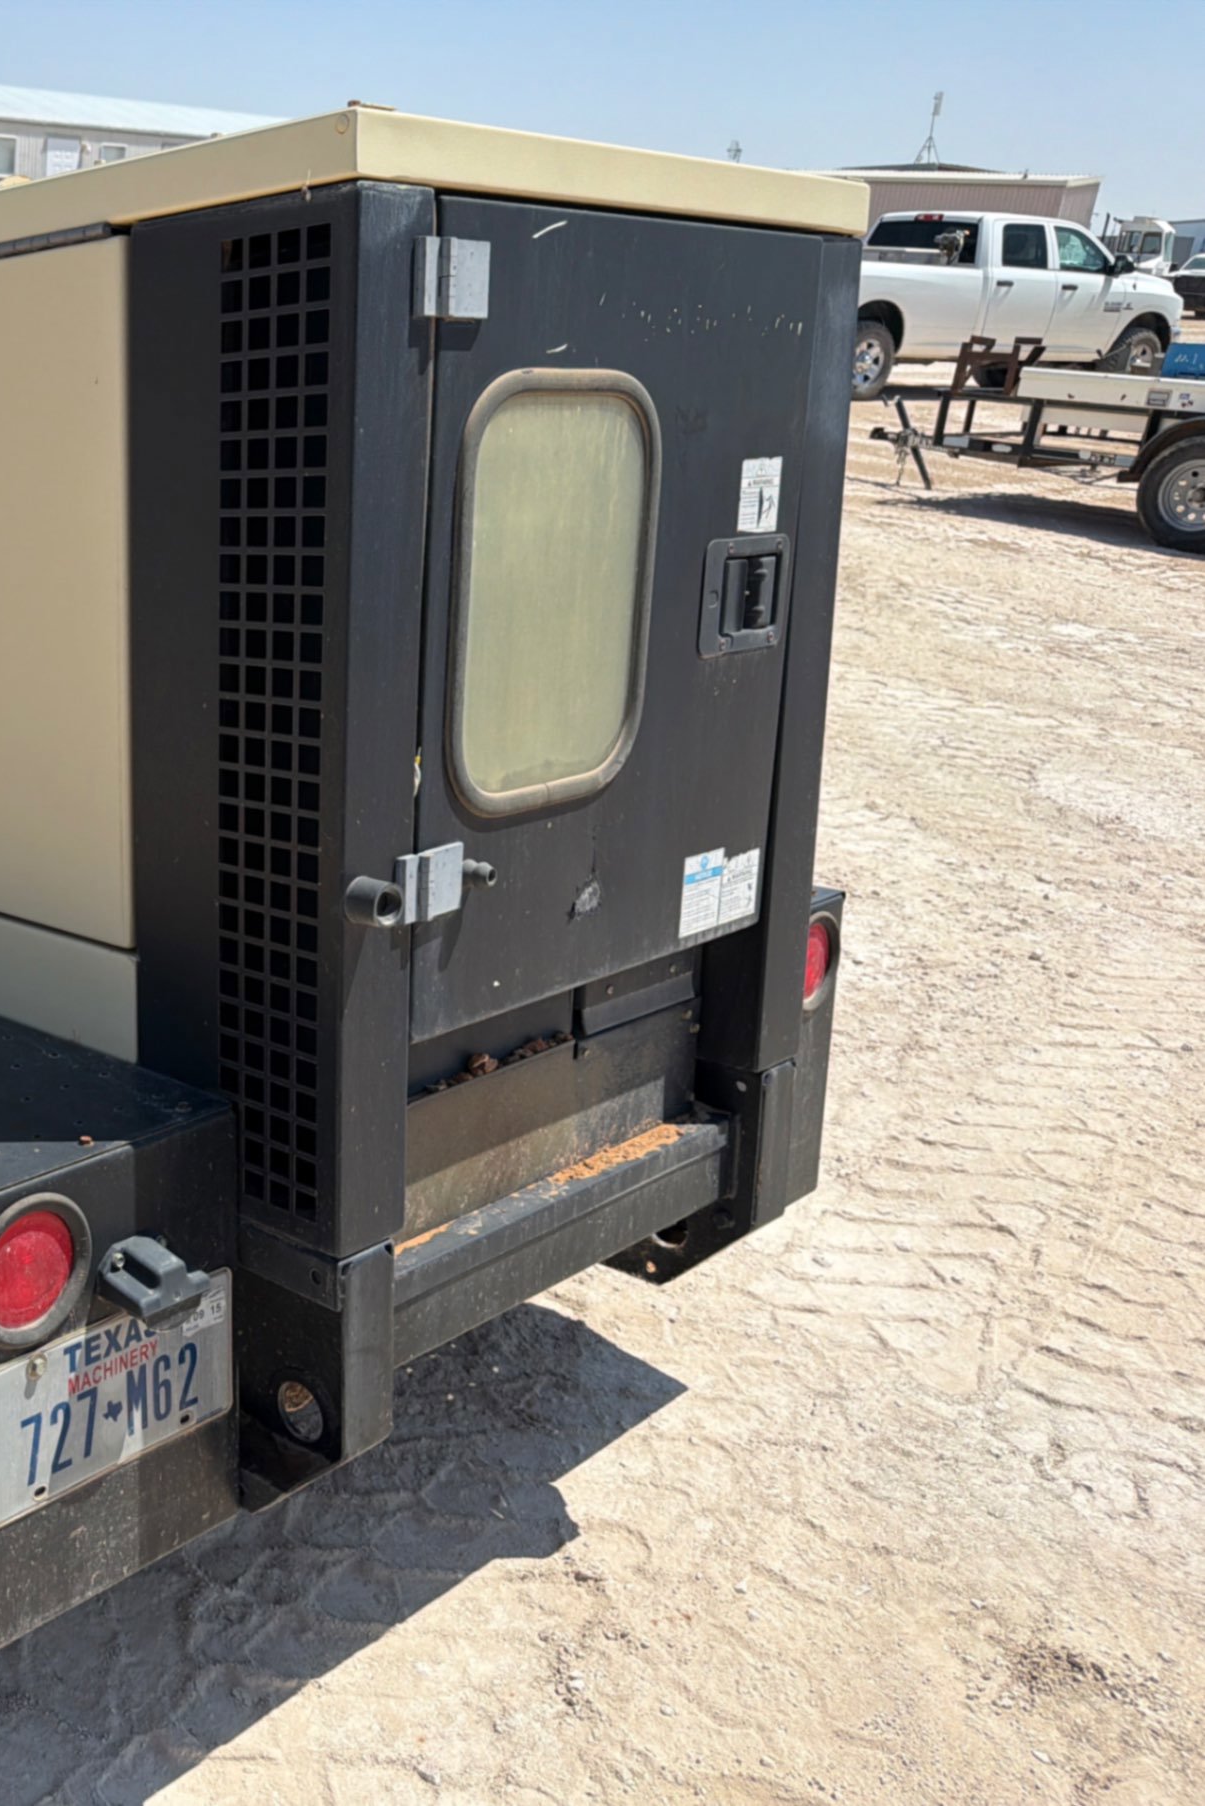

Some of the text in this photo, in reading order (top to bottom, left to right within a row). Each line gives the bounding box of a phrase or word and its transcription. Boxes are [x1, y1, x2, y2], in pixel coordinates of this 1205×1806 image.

[20, 1342, 199, 1487] 727 M62
[67, 1338, 159, 1397] MACHINERY
